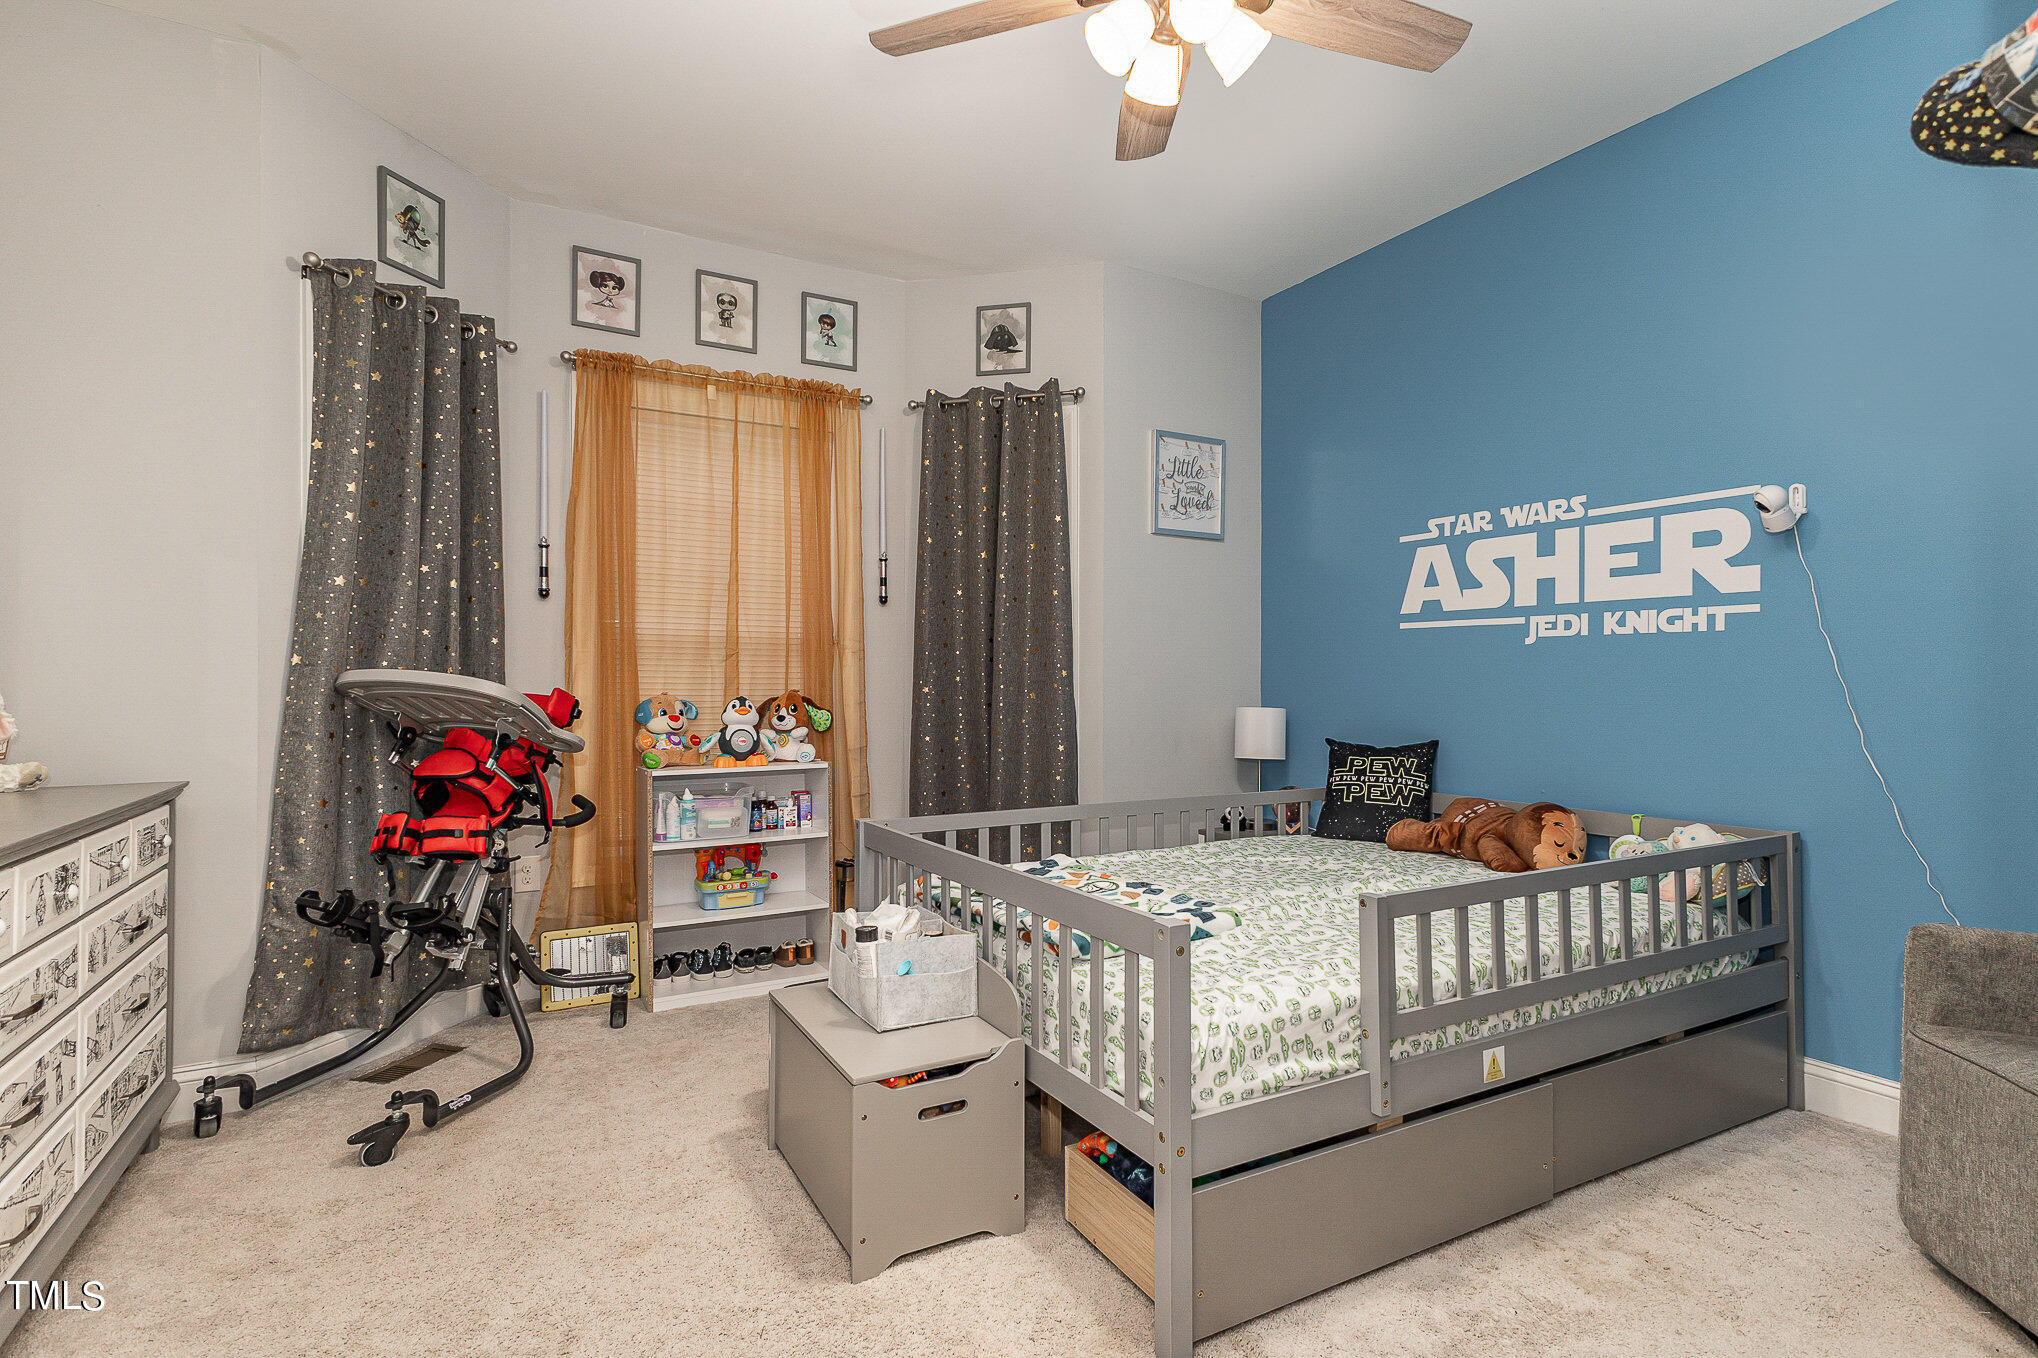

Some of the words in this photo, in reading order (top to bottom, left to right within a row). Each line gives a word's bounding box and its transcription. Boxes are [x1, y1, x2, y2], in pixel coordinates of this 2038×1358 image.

[1166, 456, 1204, 484] Little
[1170, 488, 1212, 515] Loved
[1427, 510, 1494, 539] STAR
[1500, 494, 1588, 528] WARS
[1400, 507, 1761, 615] ASHER
[1524, 612, 1589, 645] JEDI
[1603, 604, 1729, 636] KNIGHT
[1333, 756, 1427, 781] PEW
[1397, 777, 1414, 785] PEW
[1332, 782, 1426, 807] PEW
